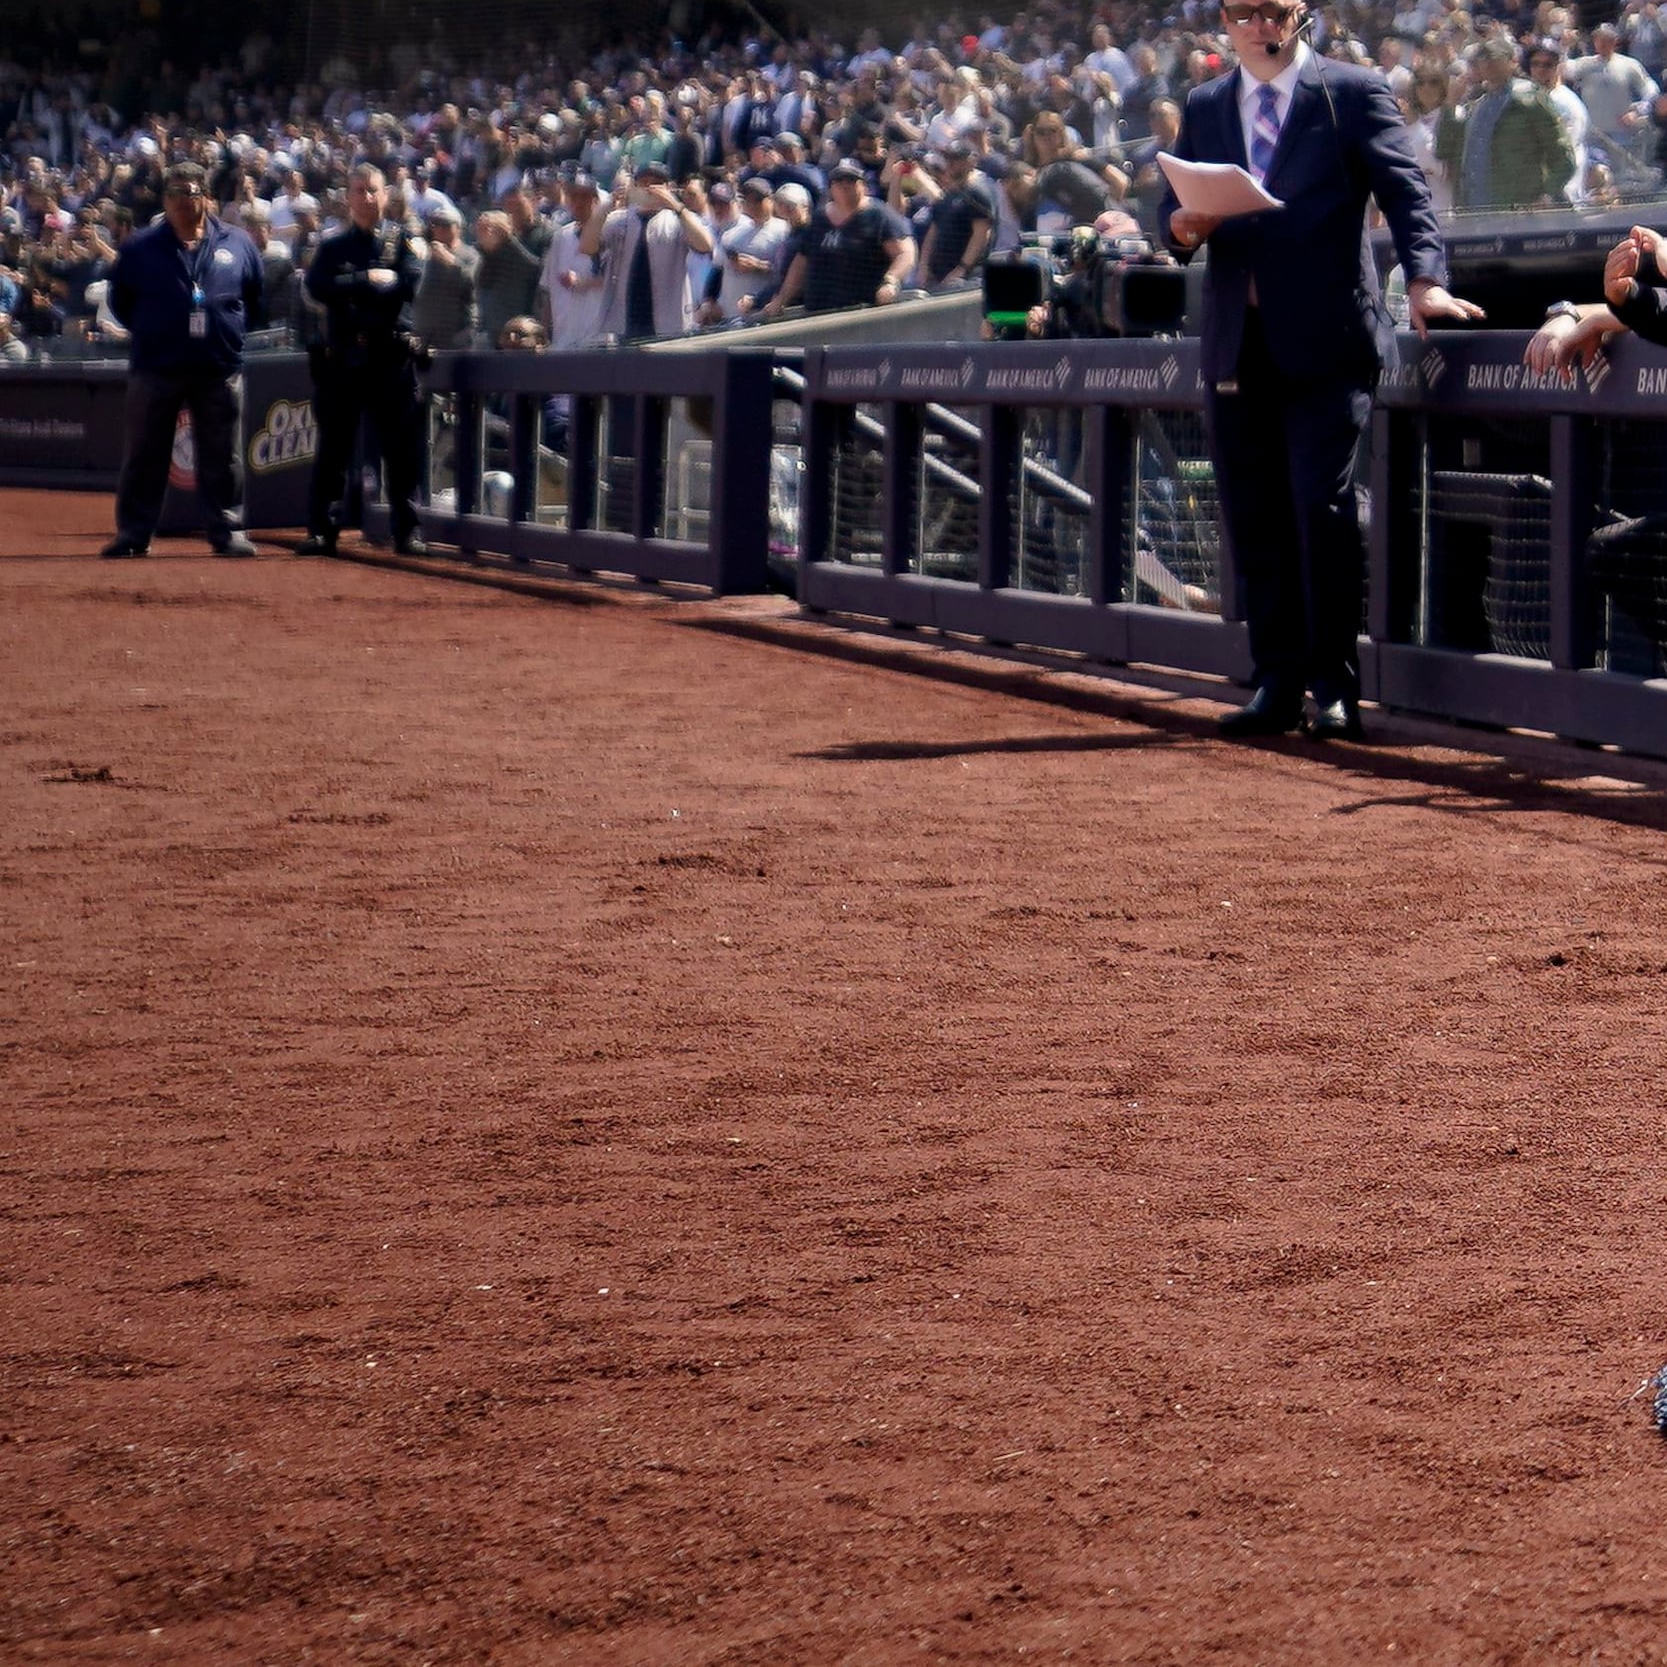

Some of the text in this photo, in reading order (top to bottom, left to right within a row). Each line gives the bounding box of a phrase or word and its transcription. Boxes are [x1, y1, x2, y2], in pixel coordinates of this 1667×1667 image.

[1084, 367, 1159, 389] BANK OF AMERICA
[1468, 365, 1500, 389] BANK
[1504, 365, 1520, 389] OF
